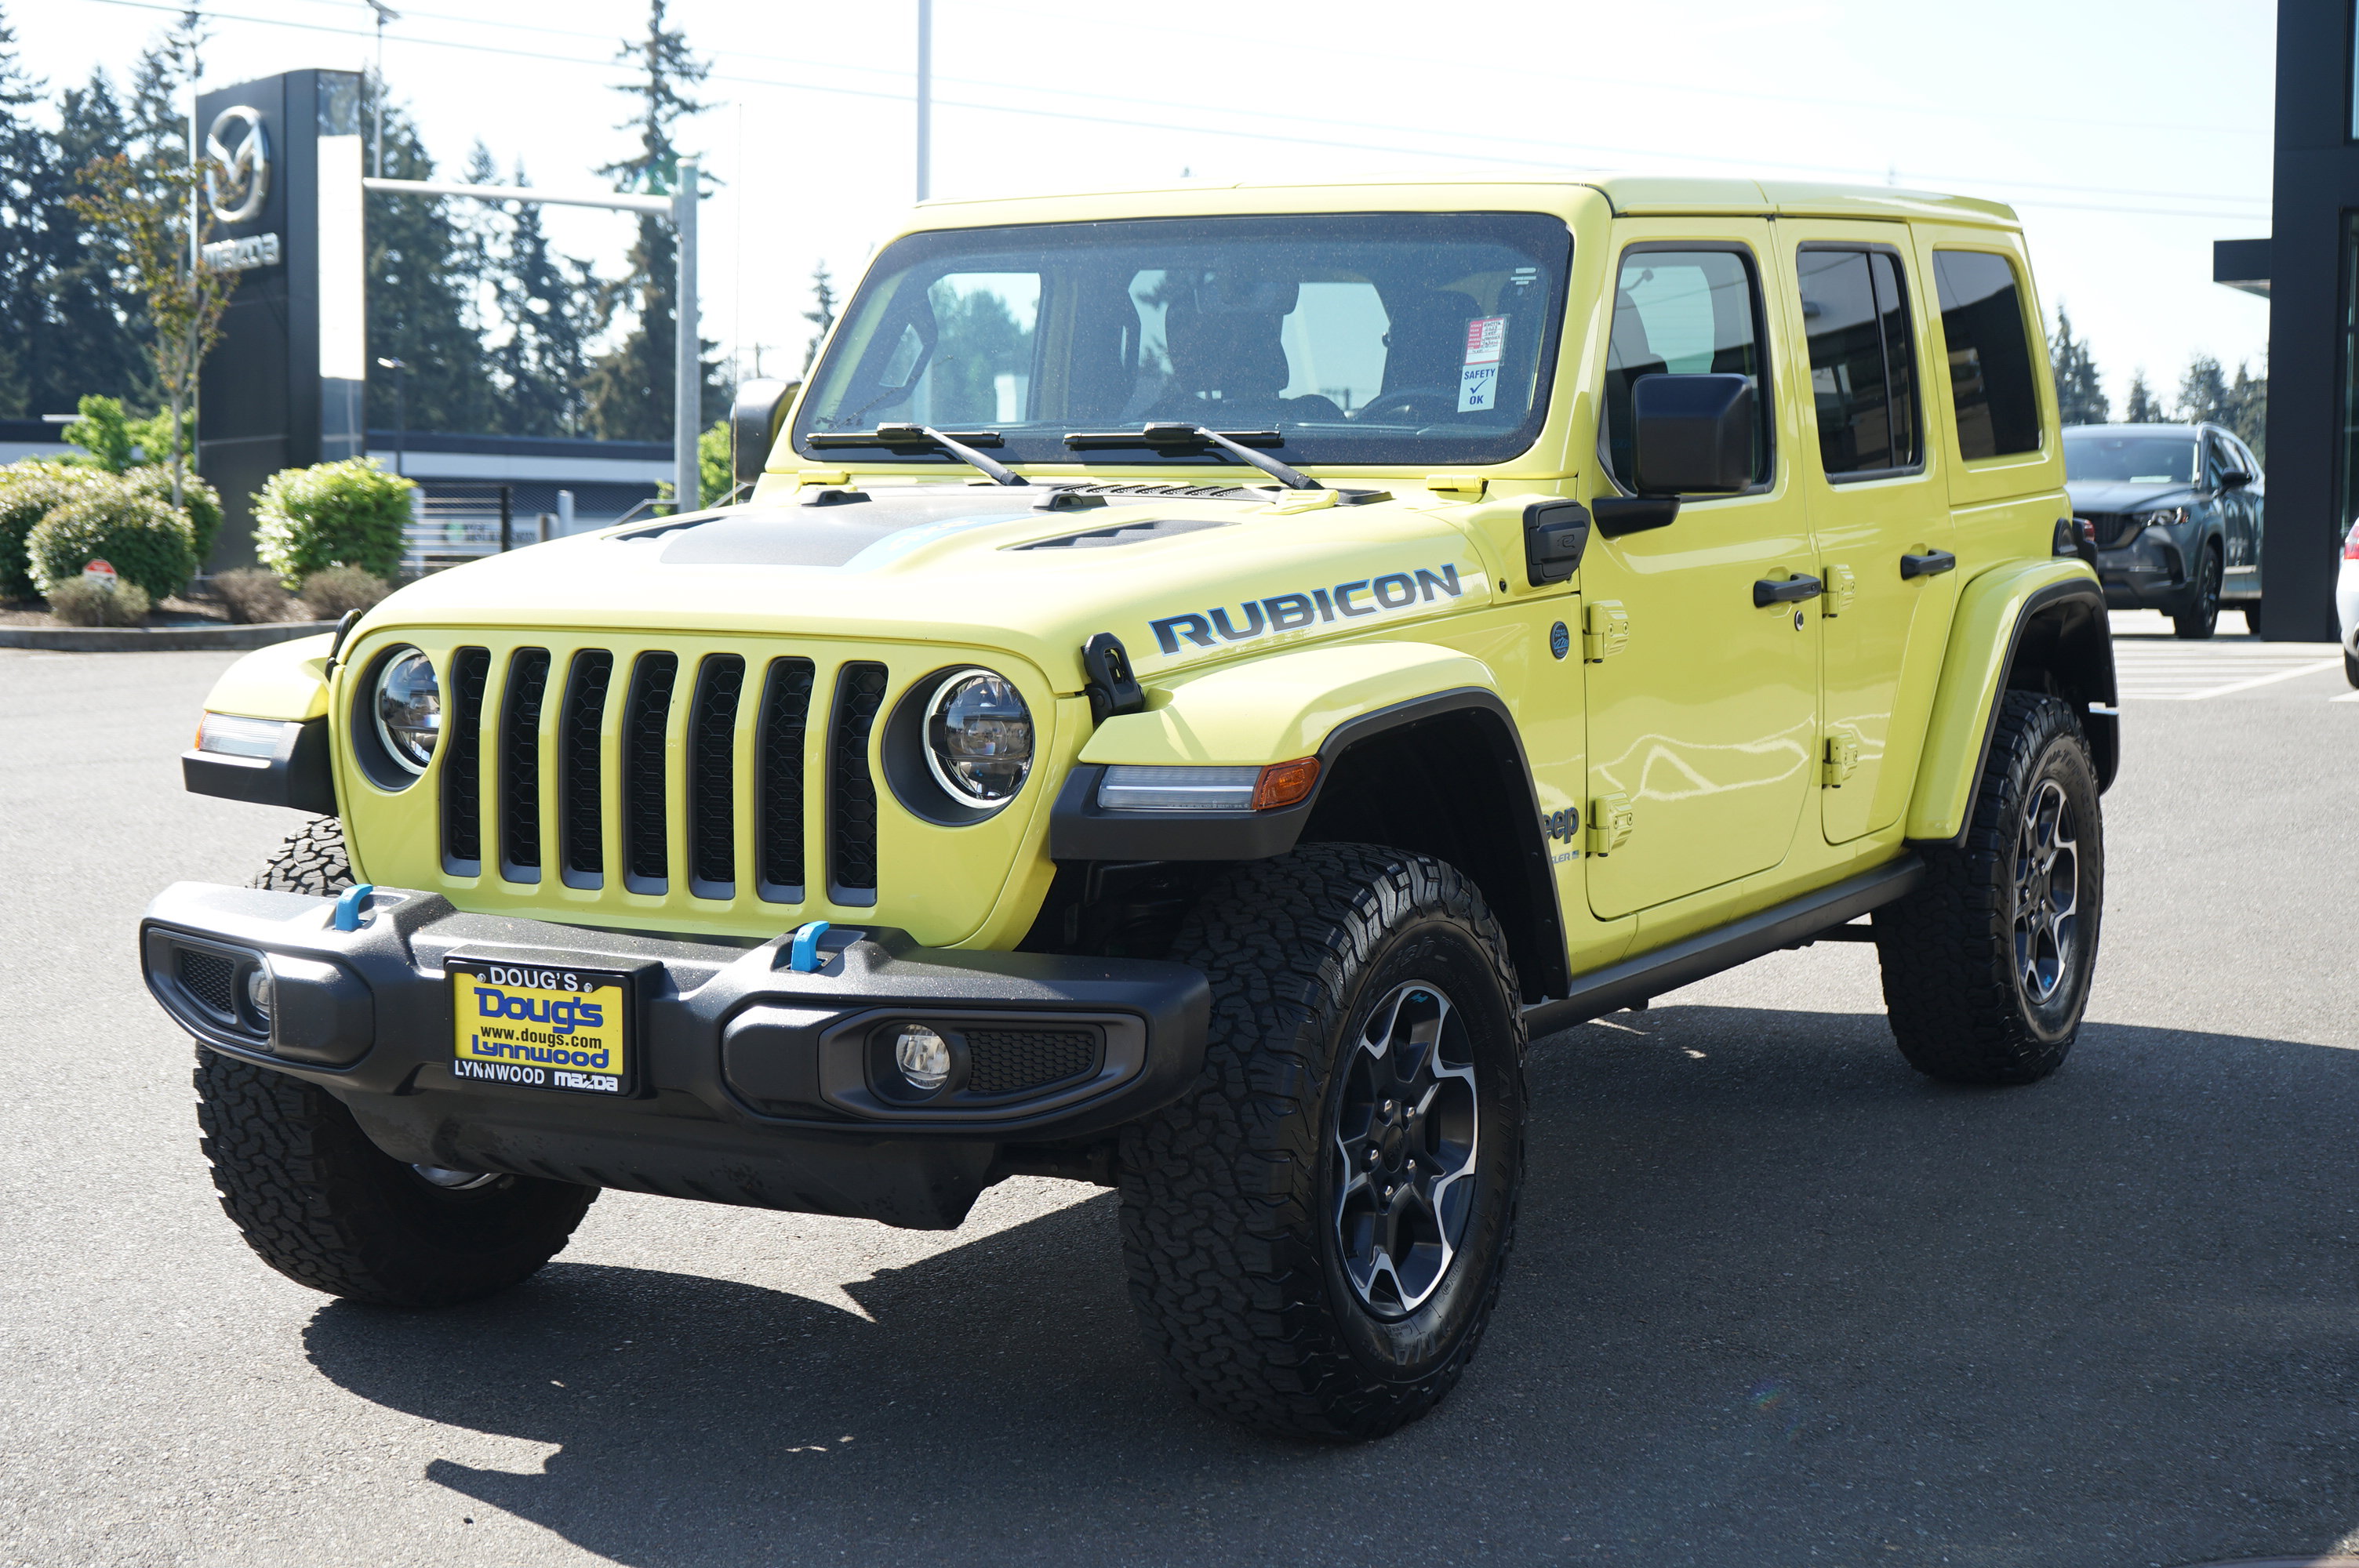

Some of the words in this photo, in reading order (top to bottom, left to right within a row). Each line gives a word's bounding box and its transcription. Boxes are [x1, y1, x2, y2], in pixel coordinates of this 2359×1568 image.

[1464, 368, 1496, 380] SAFETY
[1470, 395, 1484, 405] OK
[1148, 562, 1463, 657] RUBICON
[1543, 807, 1579, 844] eep
[1551, 852, 1570, 864] LER
[489, 967, 579, 992] DOUG'S
[474, 987, 604, 1034] Doug's
[481, 1025, 602, 1049] www.dougs.com
[472, 1034, 609, 1069] Lynnwood
[455, 1060, 545, 1084] LYNNWOOD
